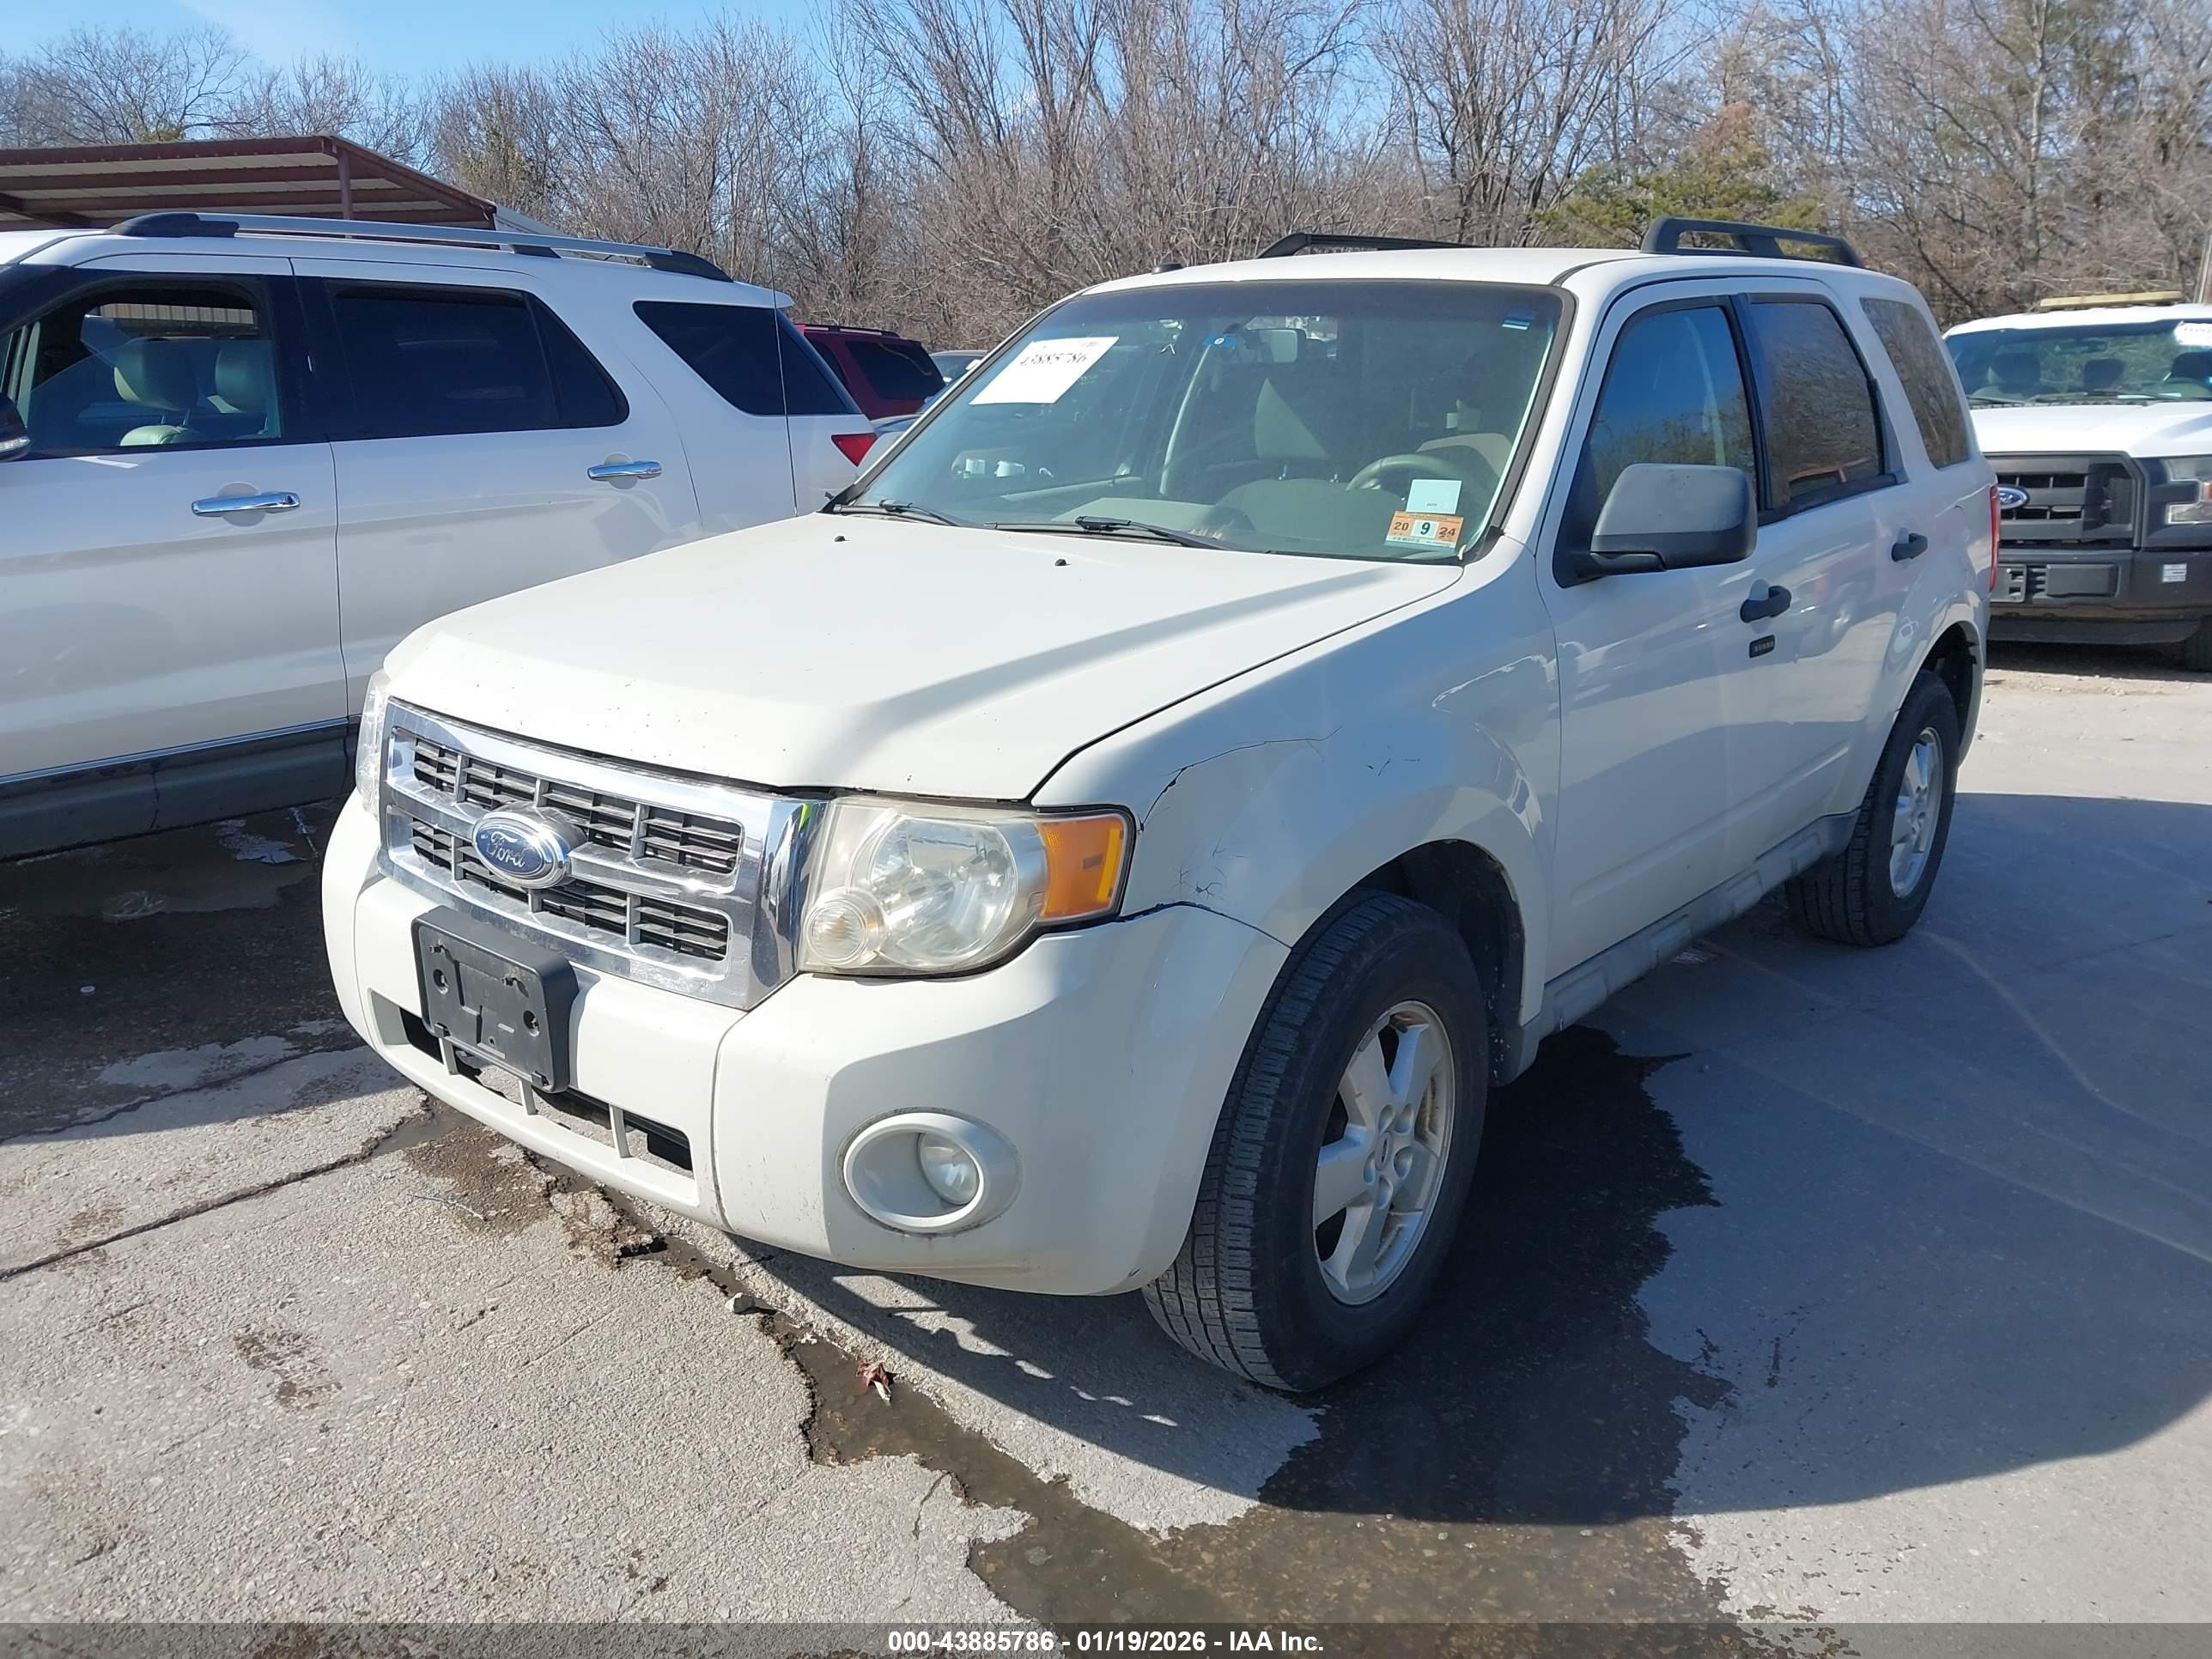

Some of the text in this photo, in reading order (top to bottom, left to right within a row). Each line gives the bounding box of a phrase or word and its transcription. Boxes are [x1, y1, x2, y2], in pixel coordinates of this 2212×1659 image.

[1394, 521, 1456, 537] 20 9 24
[486, 830, 532, 868] Ford
